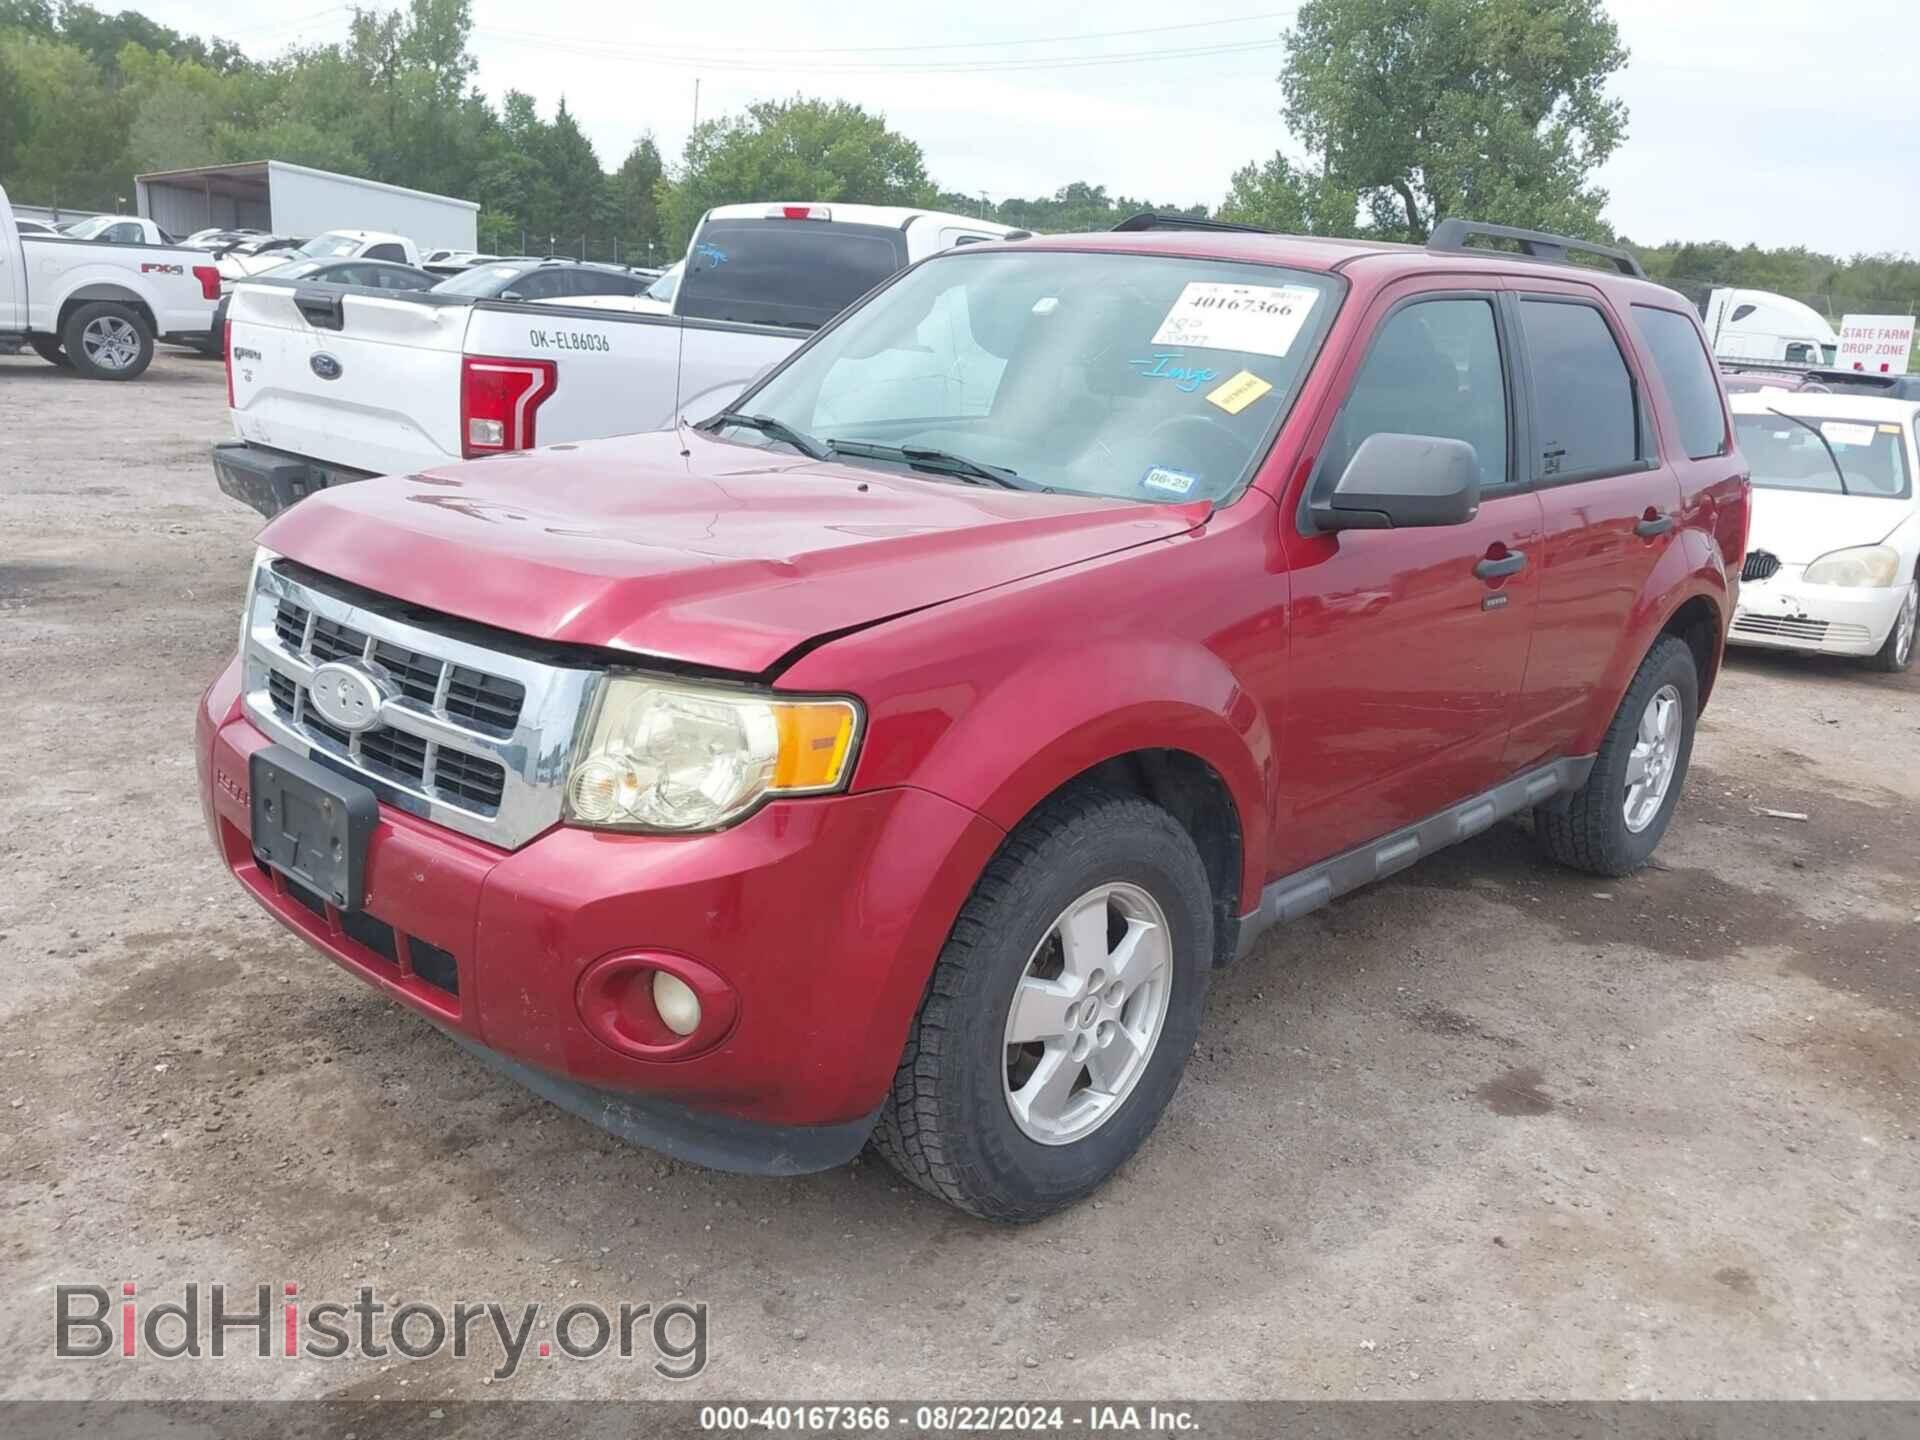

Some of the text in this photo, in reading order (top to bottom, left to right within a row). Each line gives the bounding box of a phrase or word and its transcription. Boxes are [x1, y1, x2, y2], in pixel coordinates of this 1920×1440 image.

[141, 263, 184, 275] FX4
[1188, 296, 1293, 316] 40167366
[1842, 328, 1910, 340] STATE FARM
[530, 330, 610, 352] OK-EL86036
[1842, 343, 1905, 355] DROP ZONE
